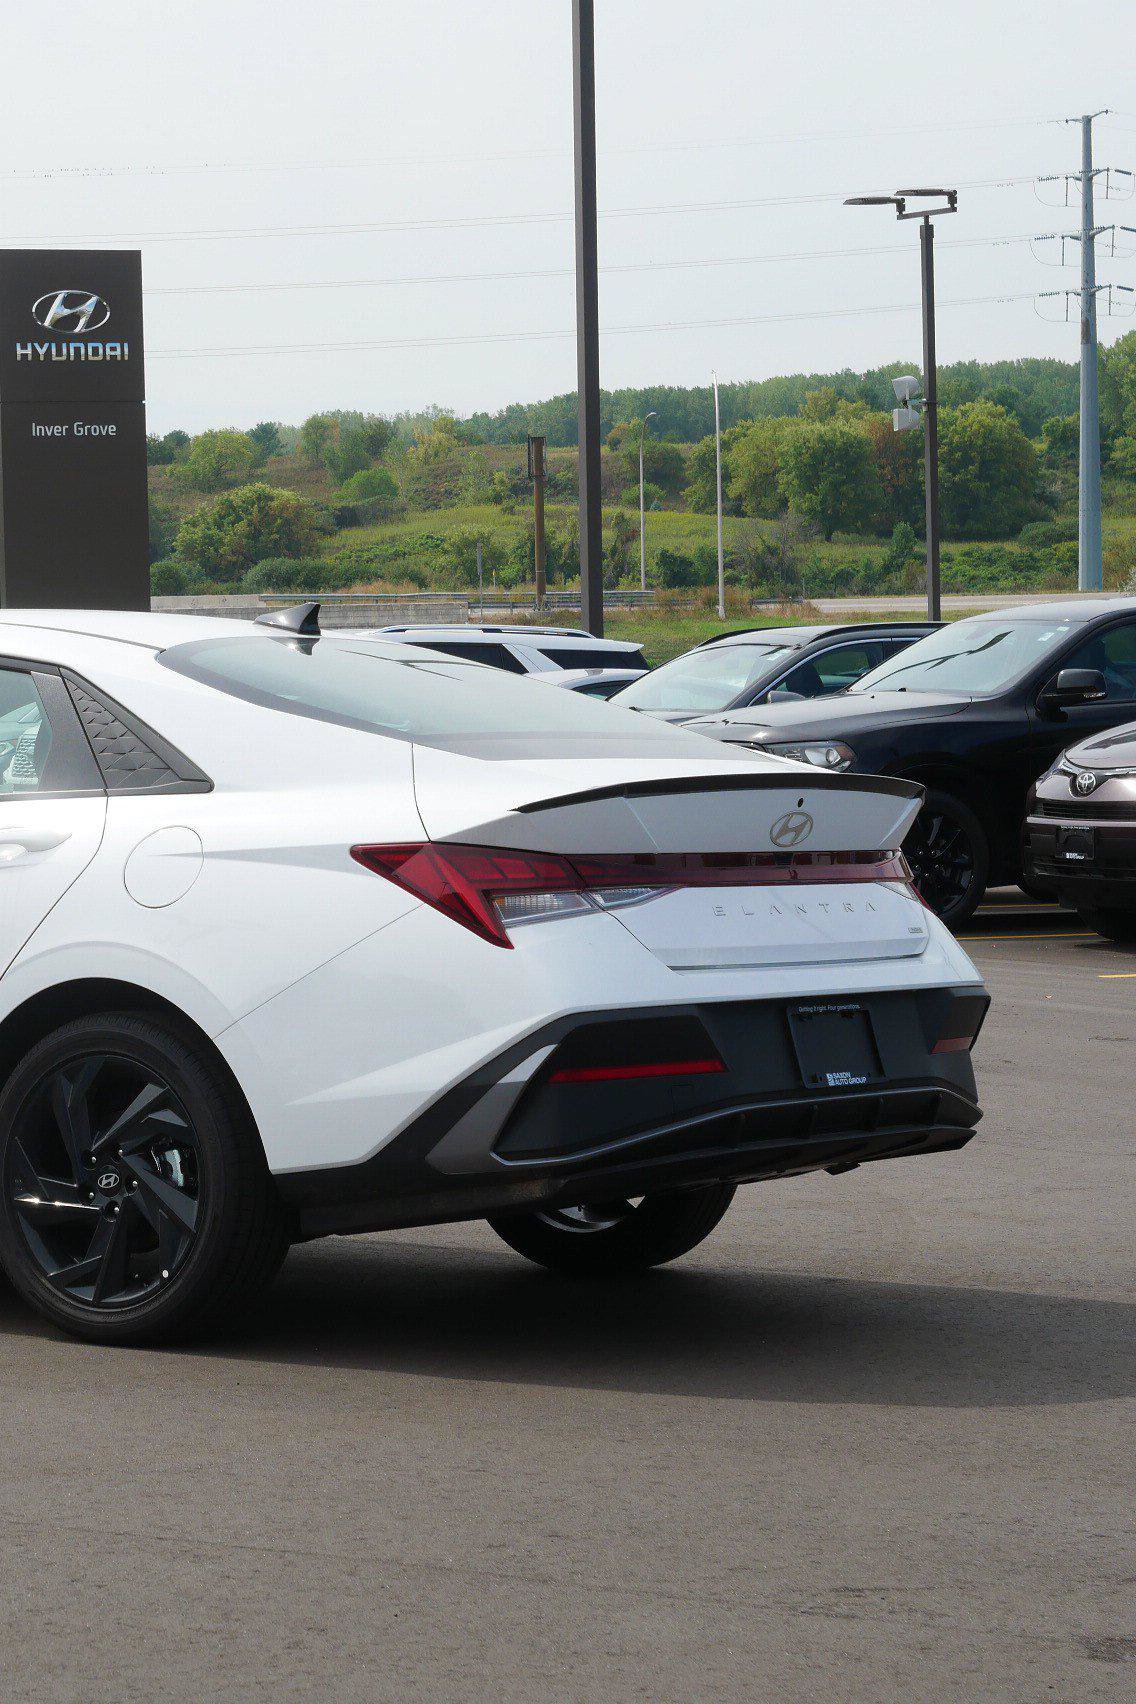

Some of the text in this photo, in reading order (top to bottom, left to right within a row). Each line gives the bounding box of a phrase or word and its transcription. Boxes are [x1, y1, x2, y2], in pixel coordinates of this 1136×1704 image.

[16, 342, 129, 361] HYUNDAI
[32, 421, 117, 437] Inver Grove
[712, 900, 877, 917] ELANTRA
[834, 1076, 867, 1086] AUTO GROUP
